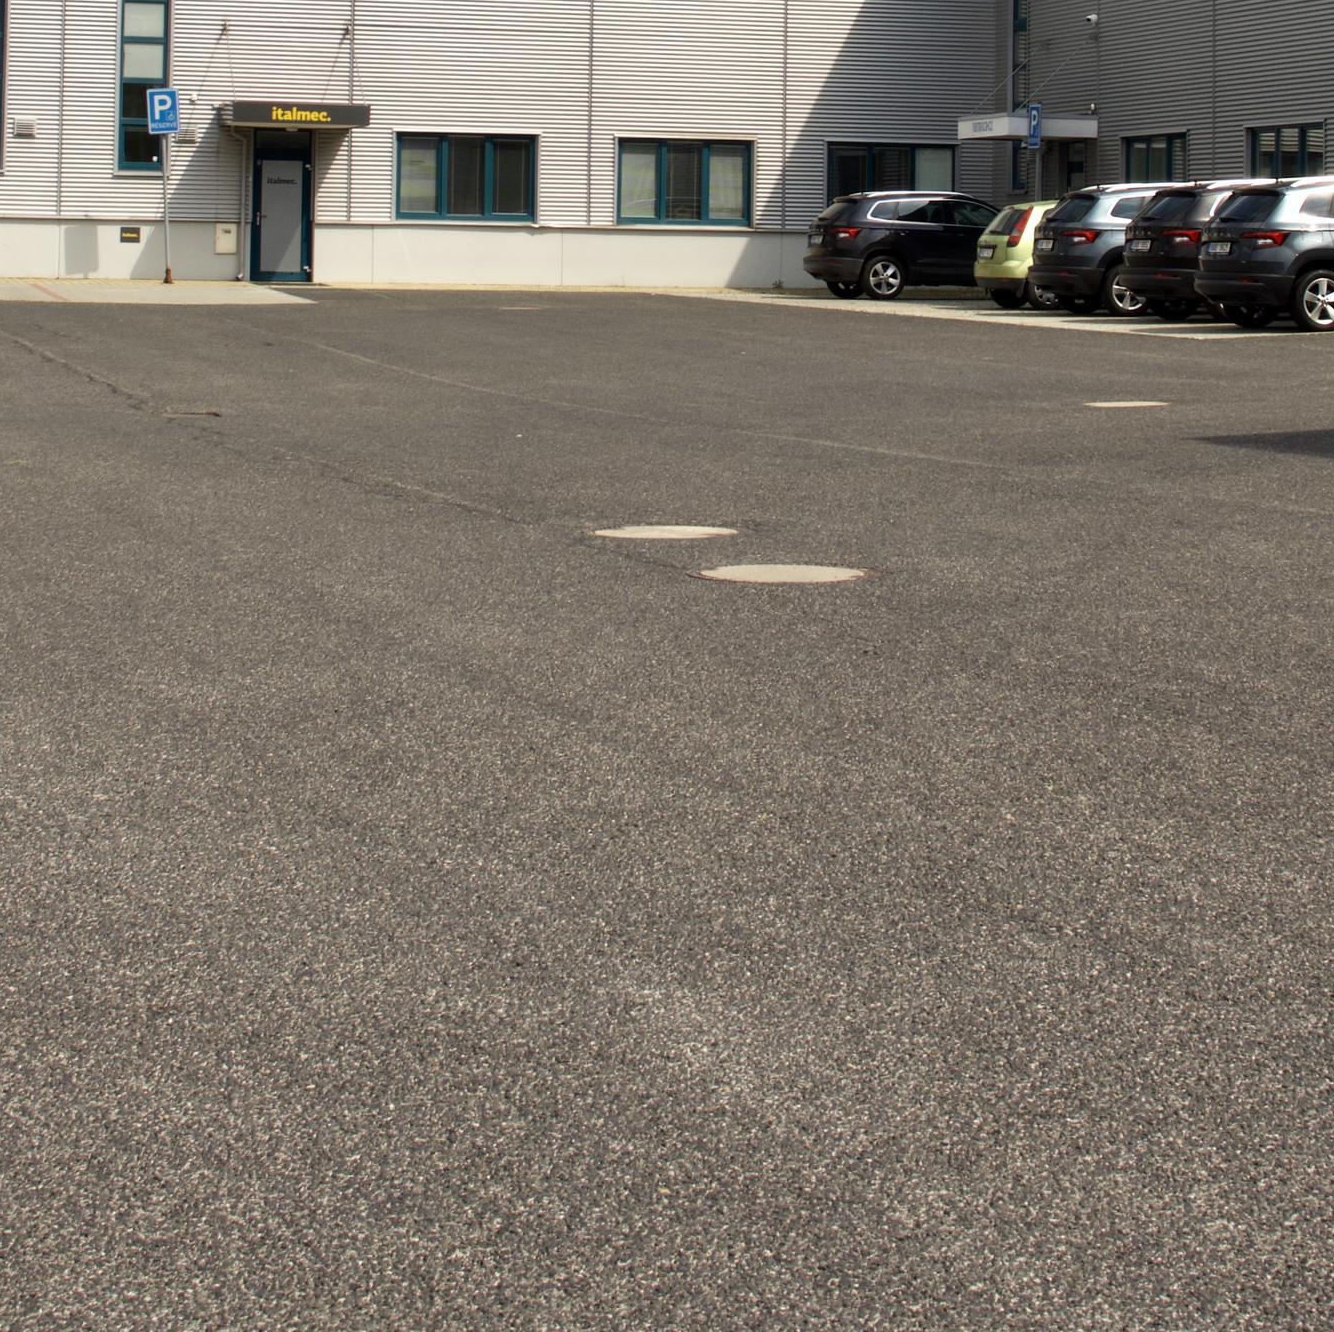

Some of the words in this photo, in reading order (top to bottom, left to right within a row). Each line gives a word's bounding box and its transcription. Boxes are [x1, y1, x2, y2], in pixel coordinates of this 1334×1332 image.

[154, 94, 172, 120] P
[271, 106, 332, 122] italmec.
[1030, 109, 1038, 135] P
